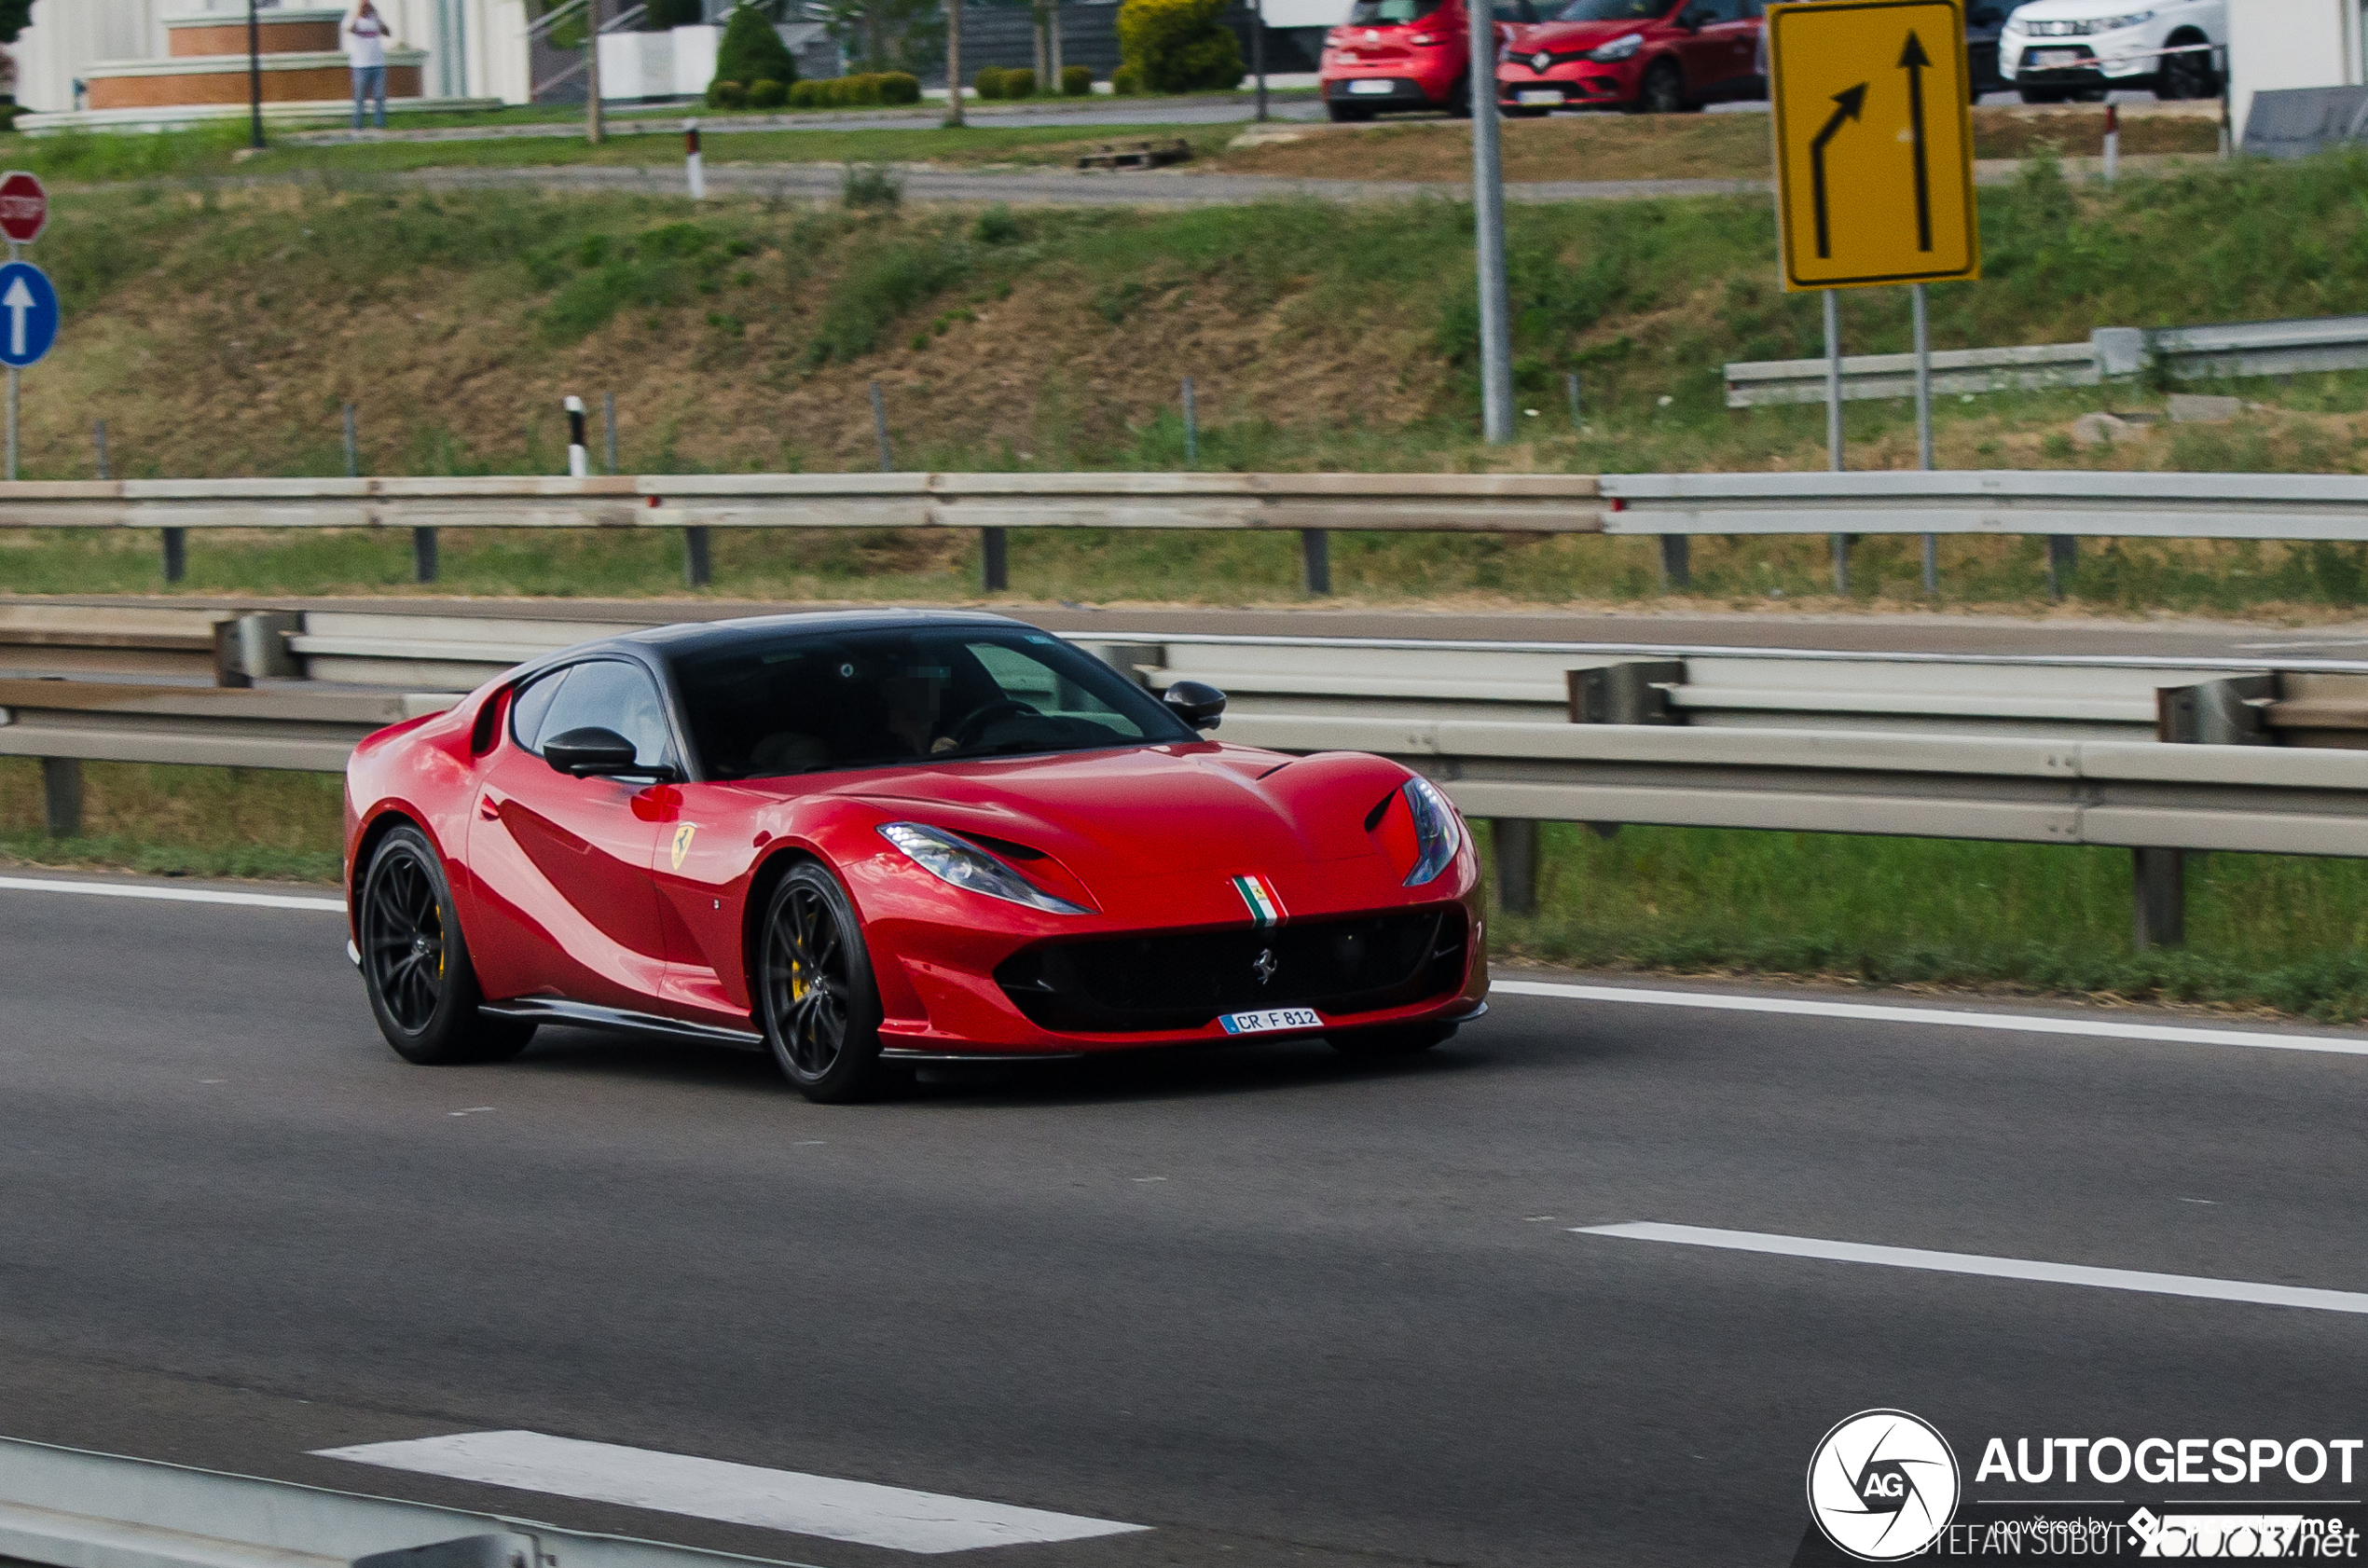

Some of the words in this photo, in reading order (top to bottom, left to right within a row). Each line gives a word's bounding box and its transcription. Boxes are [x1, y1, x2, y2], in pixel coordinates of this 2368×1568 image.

[1237, 1014, 1263, 1029] CR
[1268, 1012, 1280, 1026] F
[1283, 1011, 1318, 1025] 812
